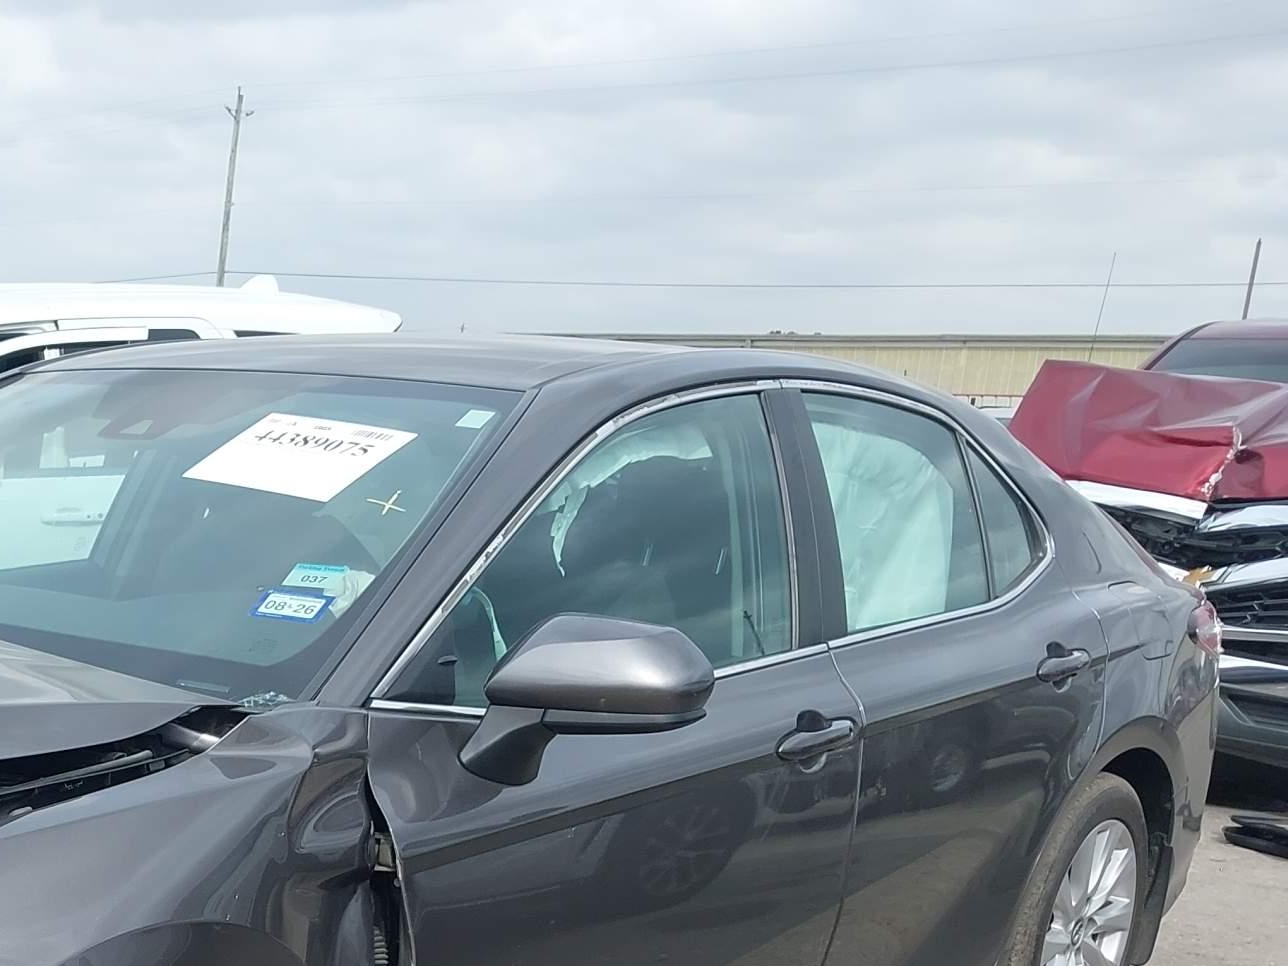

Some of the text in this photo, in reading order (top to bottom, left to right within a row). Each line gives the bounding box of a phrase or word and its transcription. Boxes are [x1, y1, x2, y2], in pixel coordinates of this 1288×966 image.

[254, 430, 376, 456] 44389075
[300, 574, 329, 583] 037
[264, 600, 288, 611] 08
[292, 603, 318, 615] 26
